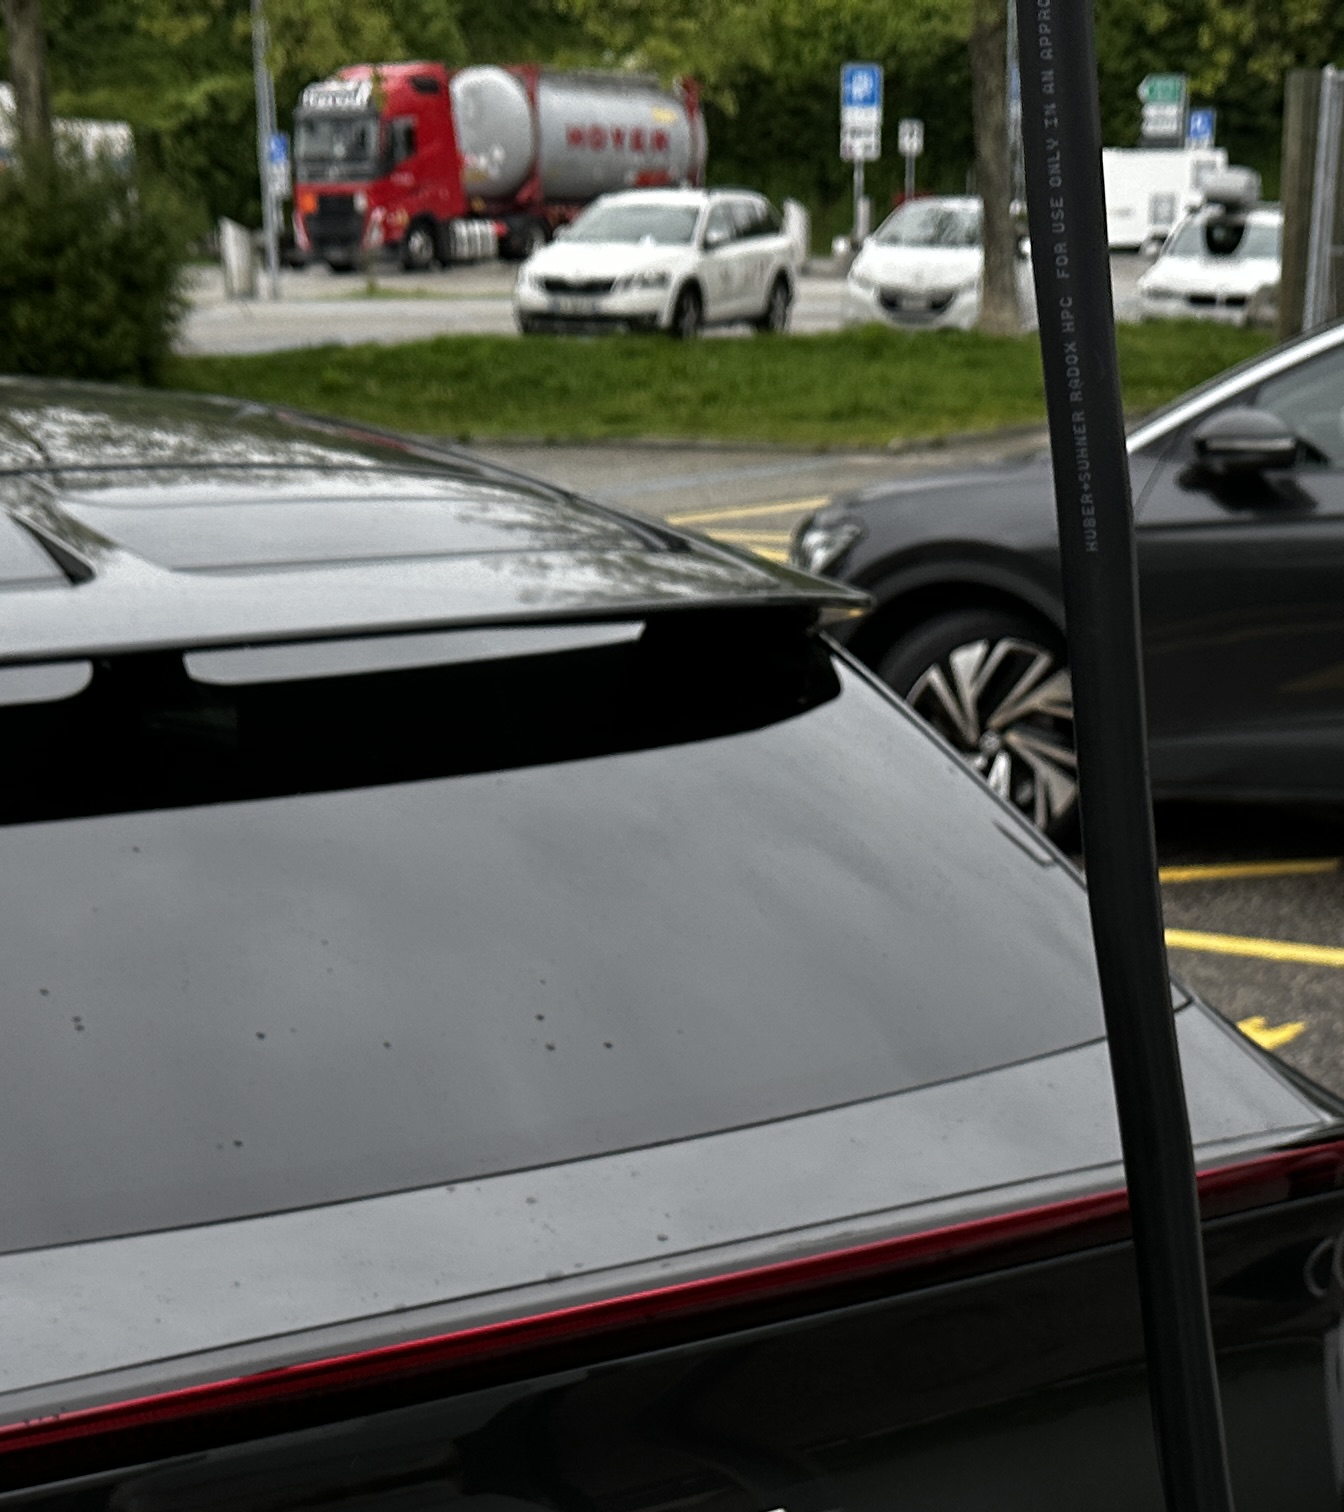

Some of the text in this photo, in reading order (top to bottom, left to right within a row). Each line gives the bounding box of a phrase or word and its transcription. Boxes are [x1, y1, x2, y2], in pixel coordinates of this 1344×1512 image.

[1041, 69, 1055, 94] AN
[1044, 103, 1058, 129] IN
[1045, 138, 1063, 188] ONLY
[1050, 197, 1066, 233] USE
[1053, 242, 1069, 279] FOR
[1059, 296, 1075, 333] HPC
[1064, 342, 1084, 403] RADOX
